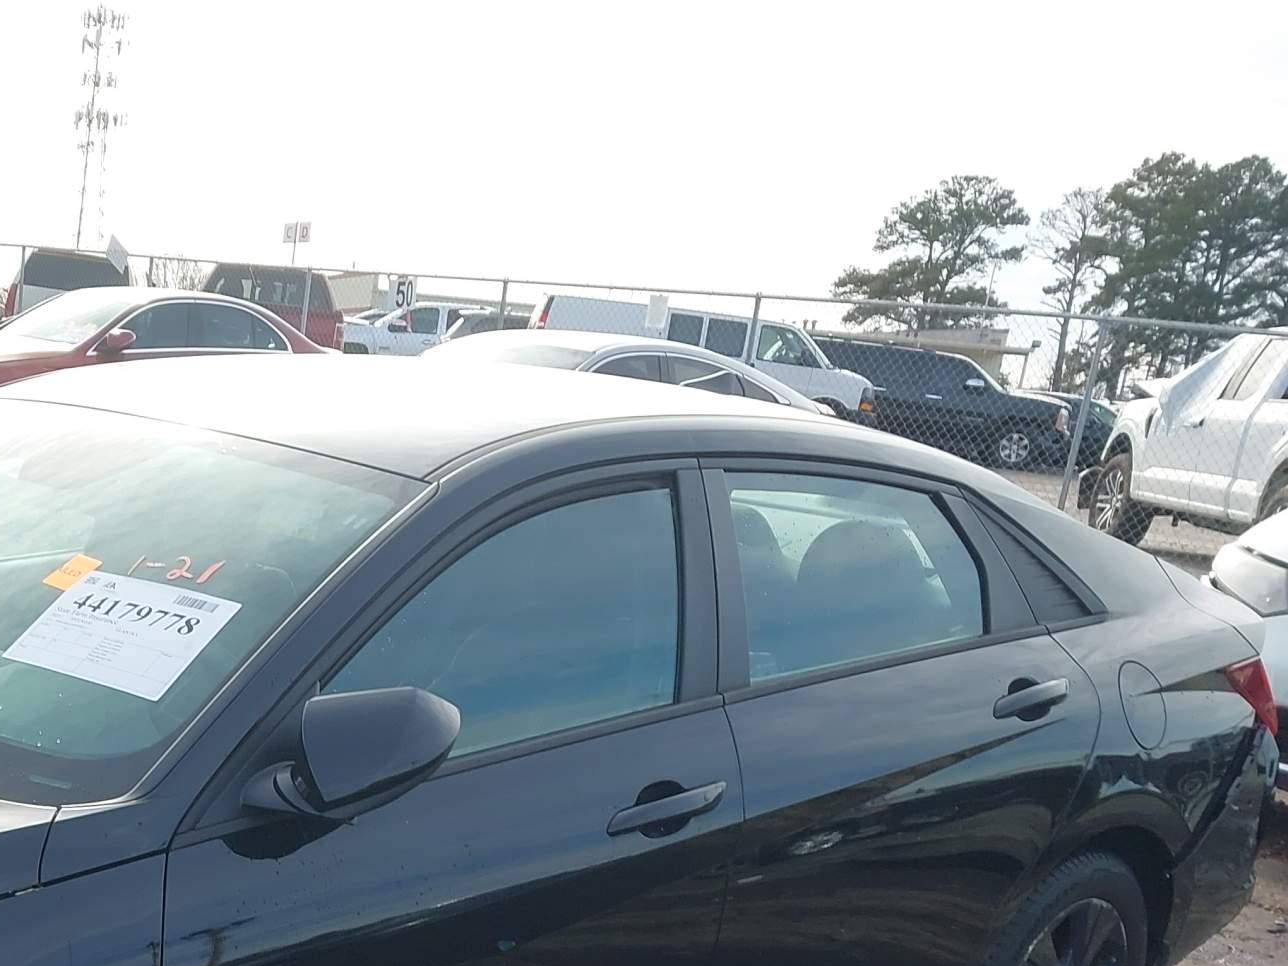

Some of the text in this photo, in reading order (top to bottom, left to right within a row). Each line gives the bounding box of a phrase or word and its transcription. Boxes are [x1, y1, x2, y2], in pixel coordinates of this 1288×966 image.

[395, 280, 413, 308] 50
[127, 555, 226, 583] 1-21
[72, 592, 201, 636] 44179778
